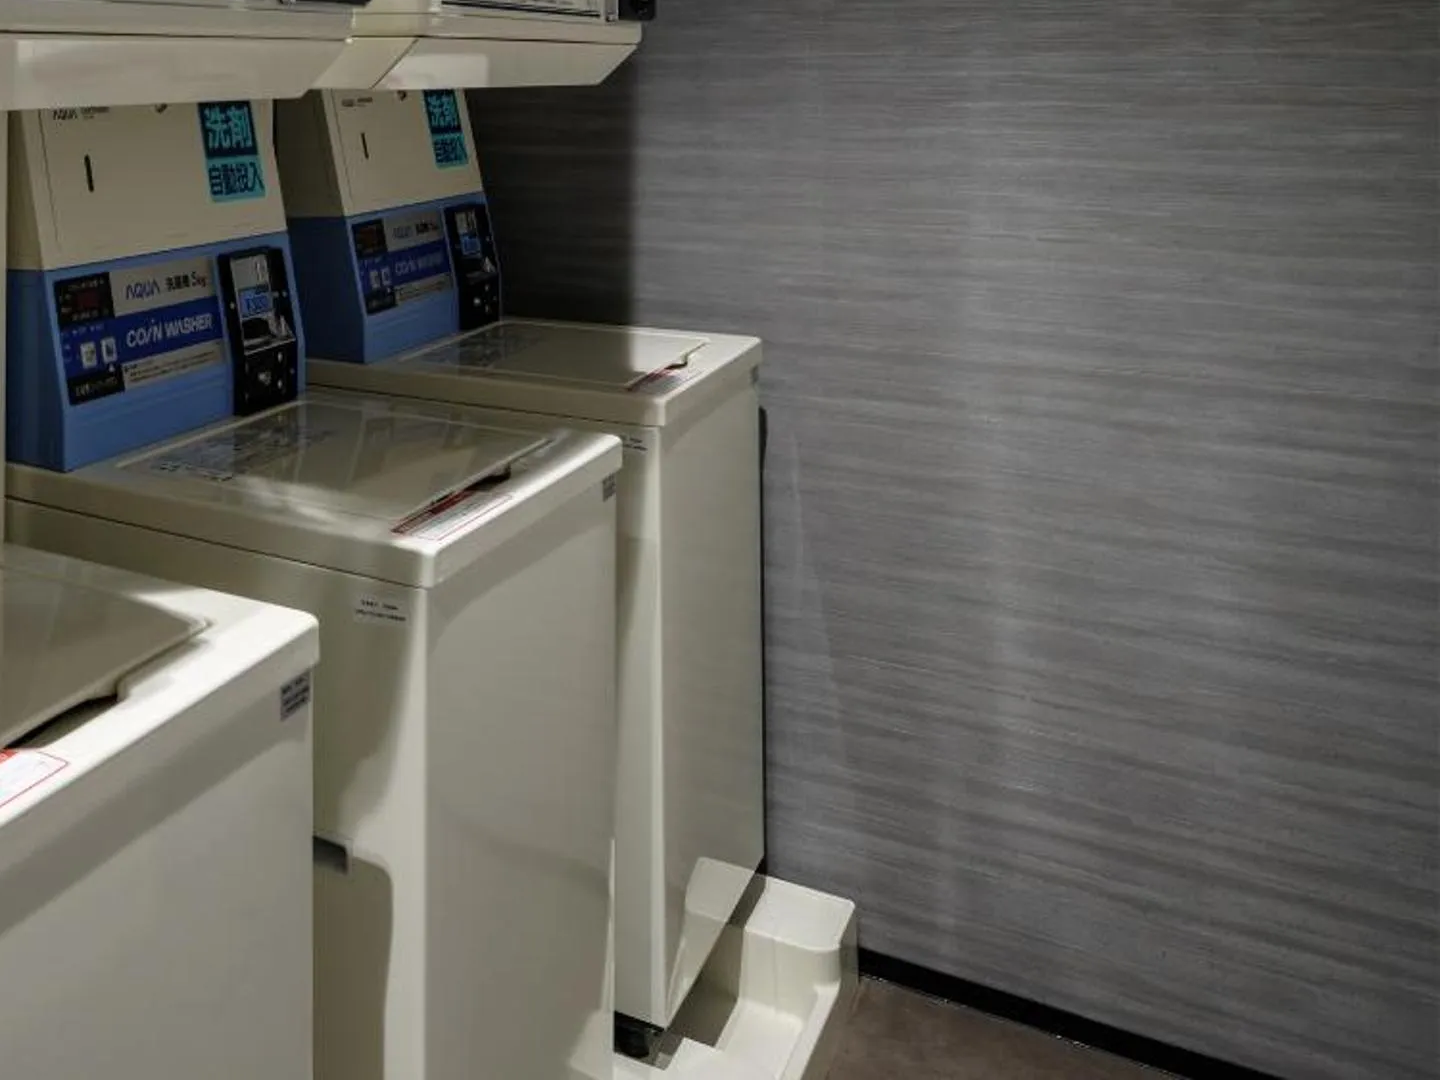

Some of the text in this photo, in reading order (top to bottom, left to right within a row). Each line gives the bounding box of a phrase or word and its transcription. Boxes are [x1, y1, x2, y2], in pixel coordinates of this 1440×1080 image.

[203, 106, 253, 149] 洗剤
[125, 278, 161, 301] AQUA
[164, 311, 214, 338] WASHER
